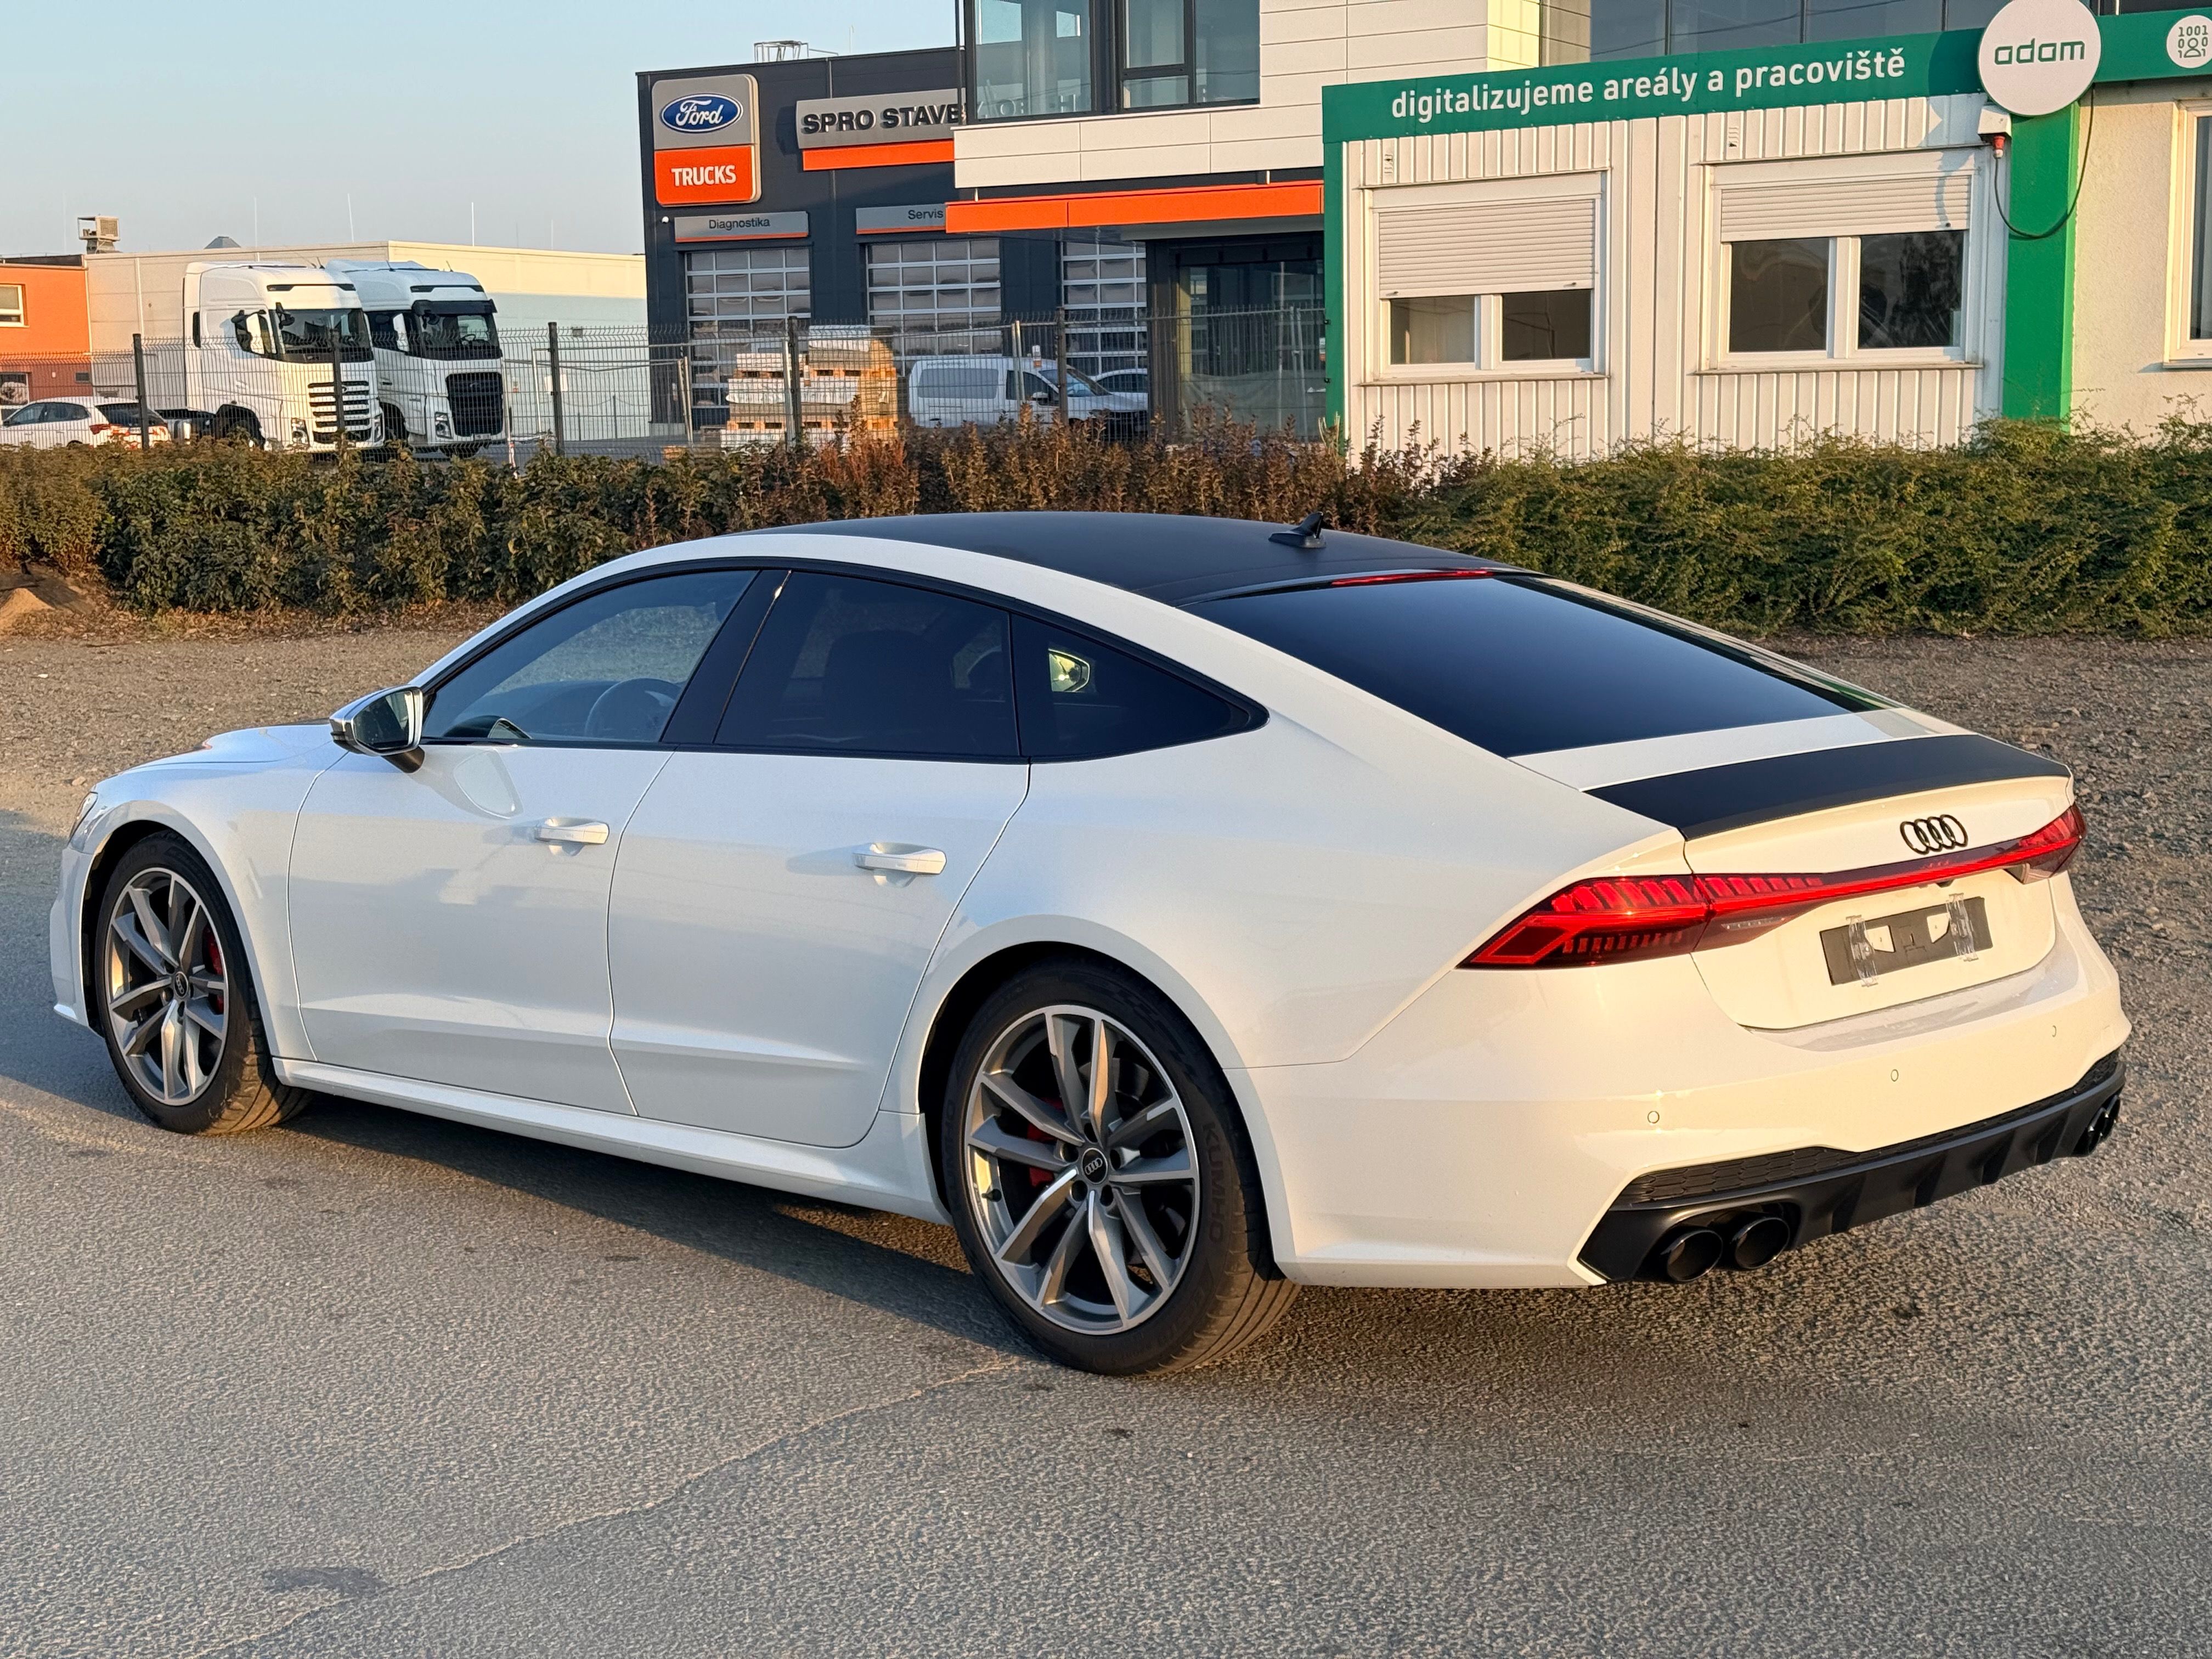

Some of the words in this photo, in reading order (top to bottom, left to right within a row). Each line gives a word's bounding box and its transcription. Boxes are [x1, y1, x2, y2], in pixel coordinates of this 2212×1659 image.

[2178, 25, 2209, 37] 1001
[1994, 38, 2085, 65] adam
[1391, 80, 1593, 123] digitalizujeme
[1604, 67, 1698, 102] areály
[1707, 70, 1724, 92] a
[1735, 47, 1905, 98] pracoviště
[675, 99, 724, 127] Ford
[803, 110, 875, 134] SPRO
[671, 164, 737, 187] TRUCKS
[708, 217, 771, 230] Diagnostika
[907, 207, 944, 220] Servis
